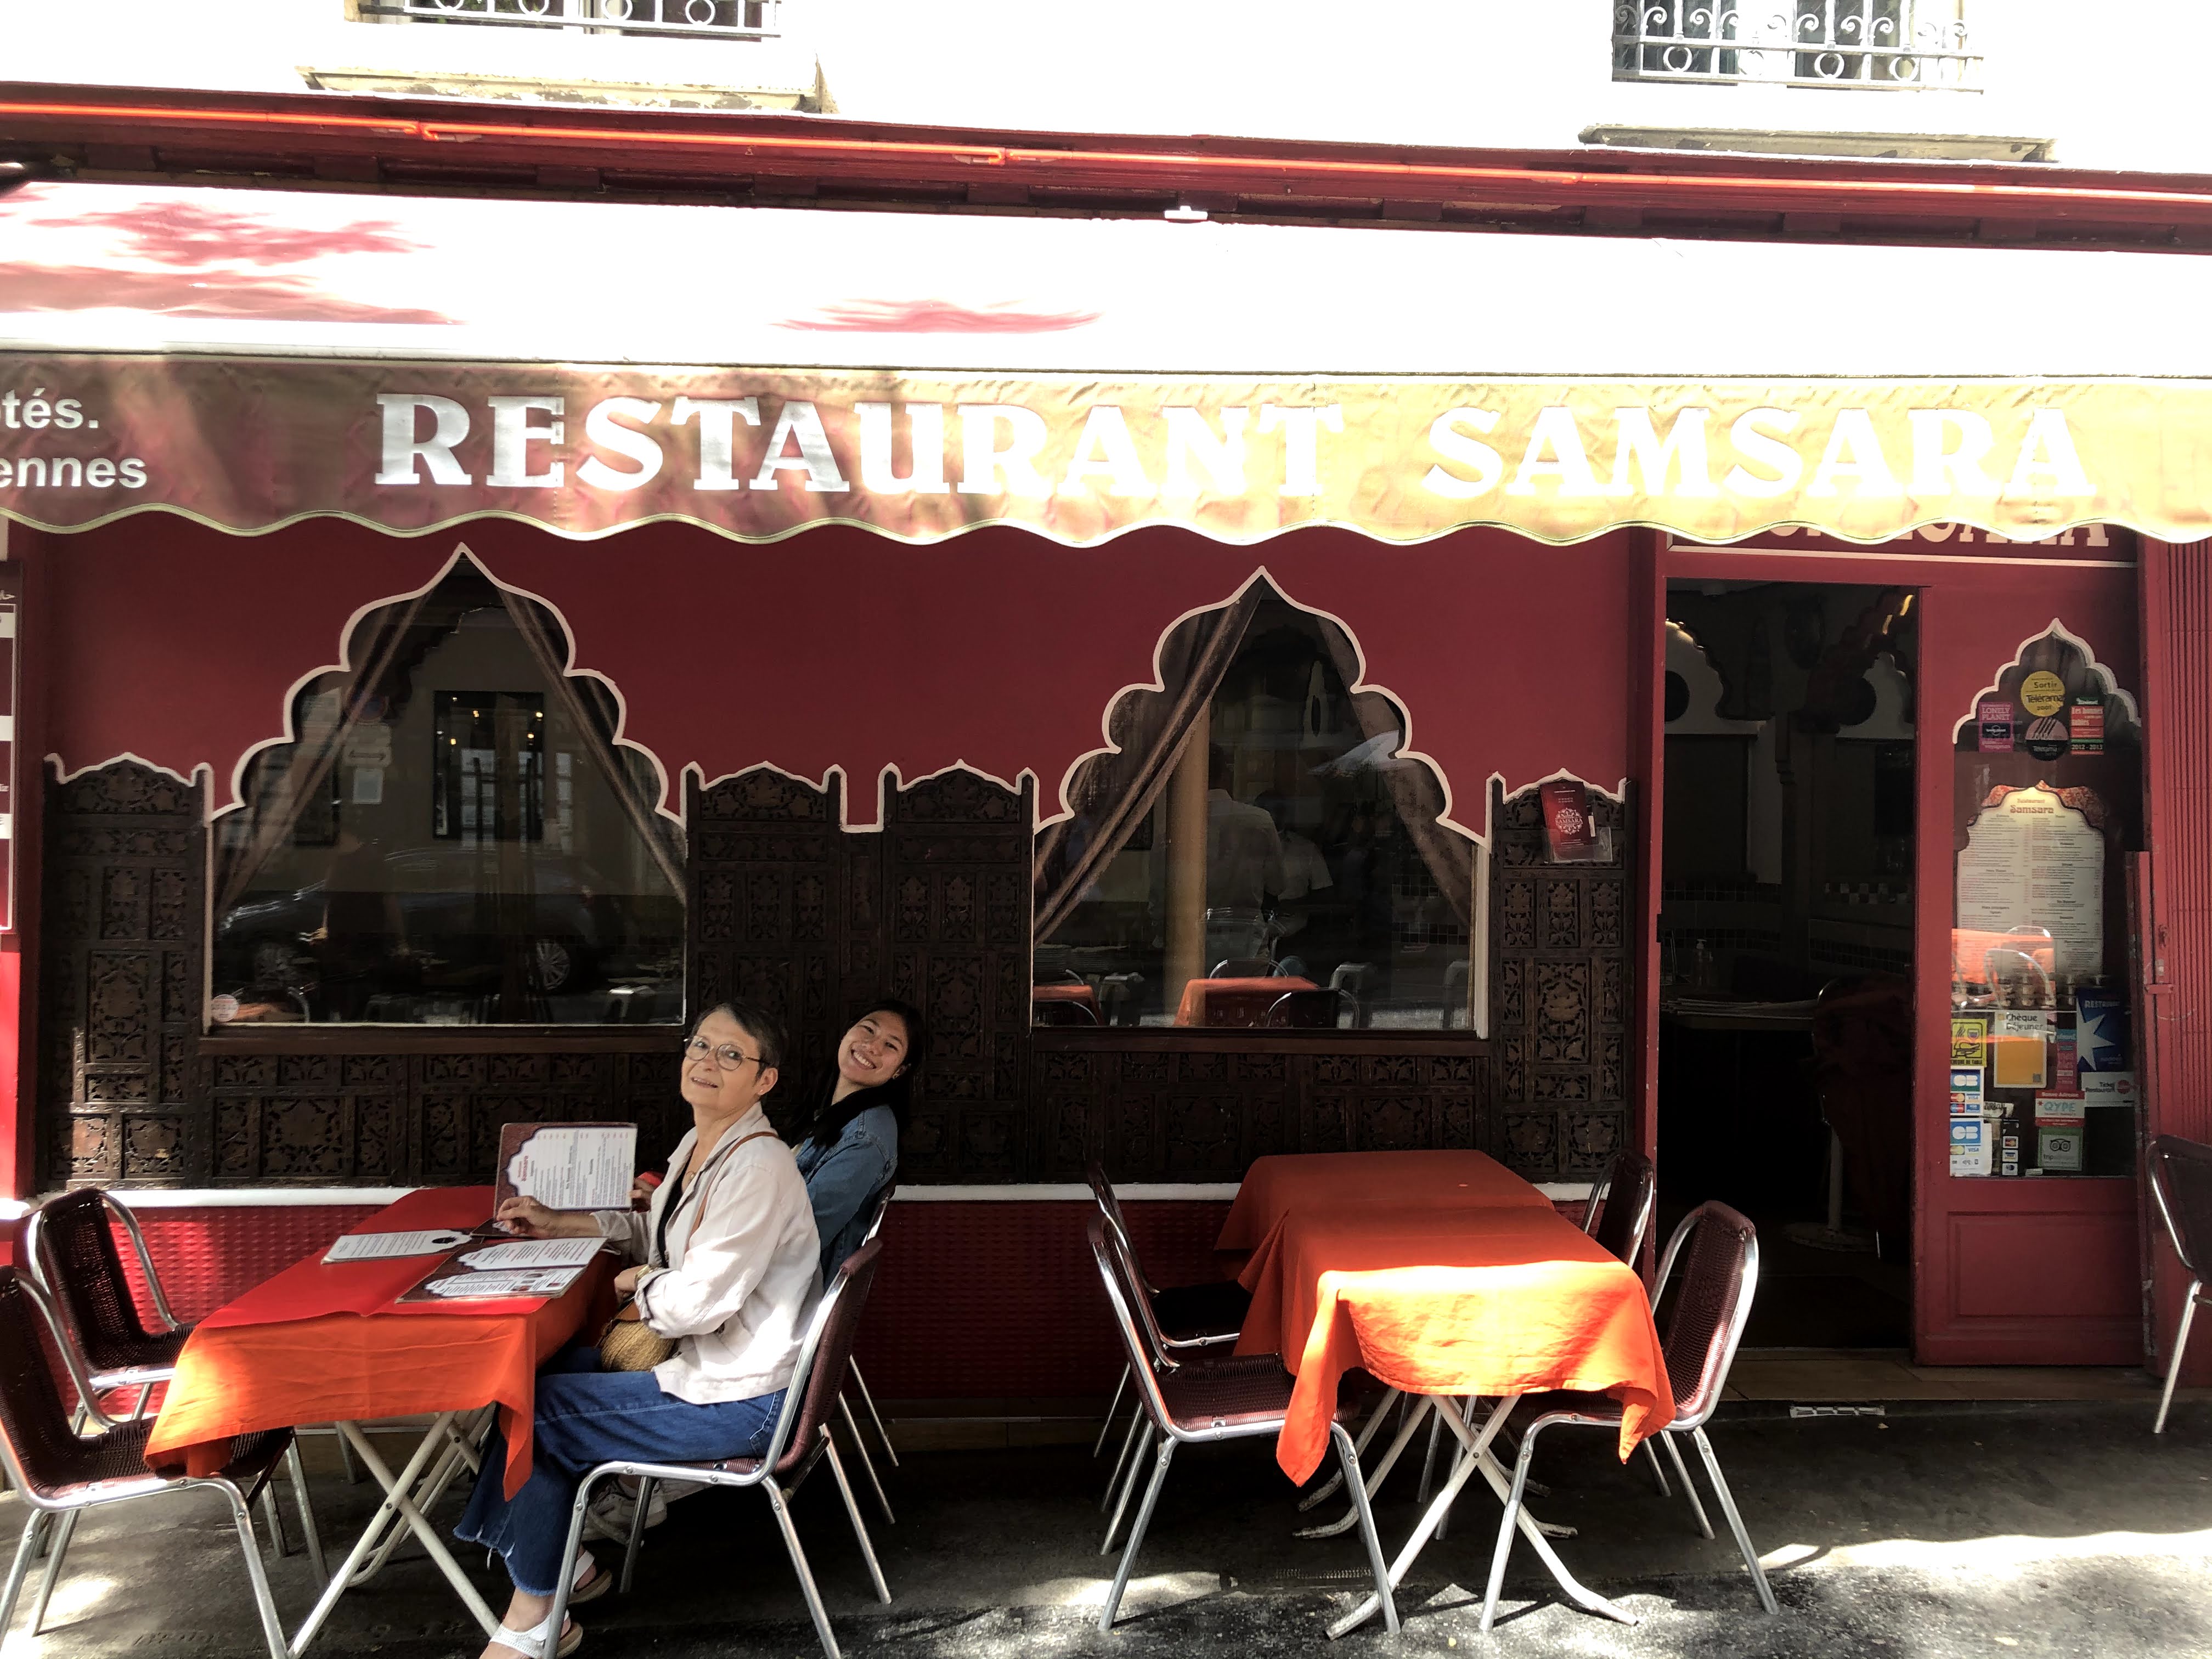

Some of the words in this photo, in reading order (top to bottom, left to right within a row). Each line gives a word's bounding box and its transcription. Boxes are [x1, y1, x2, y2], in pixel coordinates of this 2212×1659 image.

[0, 387, 99, 428] tés.
[375, 393, 1344, 496] RESTAURANT
[1421, 406, 2096, 498] SAMSARA
[2034, 680, 2057, 689] Sortir
[2010, 805, 2054, 814] Samsara
[2006, 1013, 2038, 1022] Chèque
[2006, 1022, 2044, 1031] Déjeuner
[2044, 1102, 2076, 1111] QYPE
